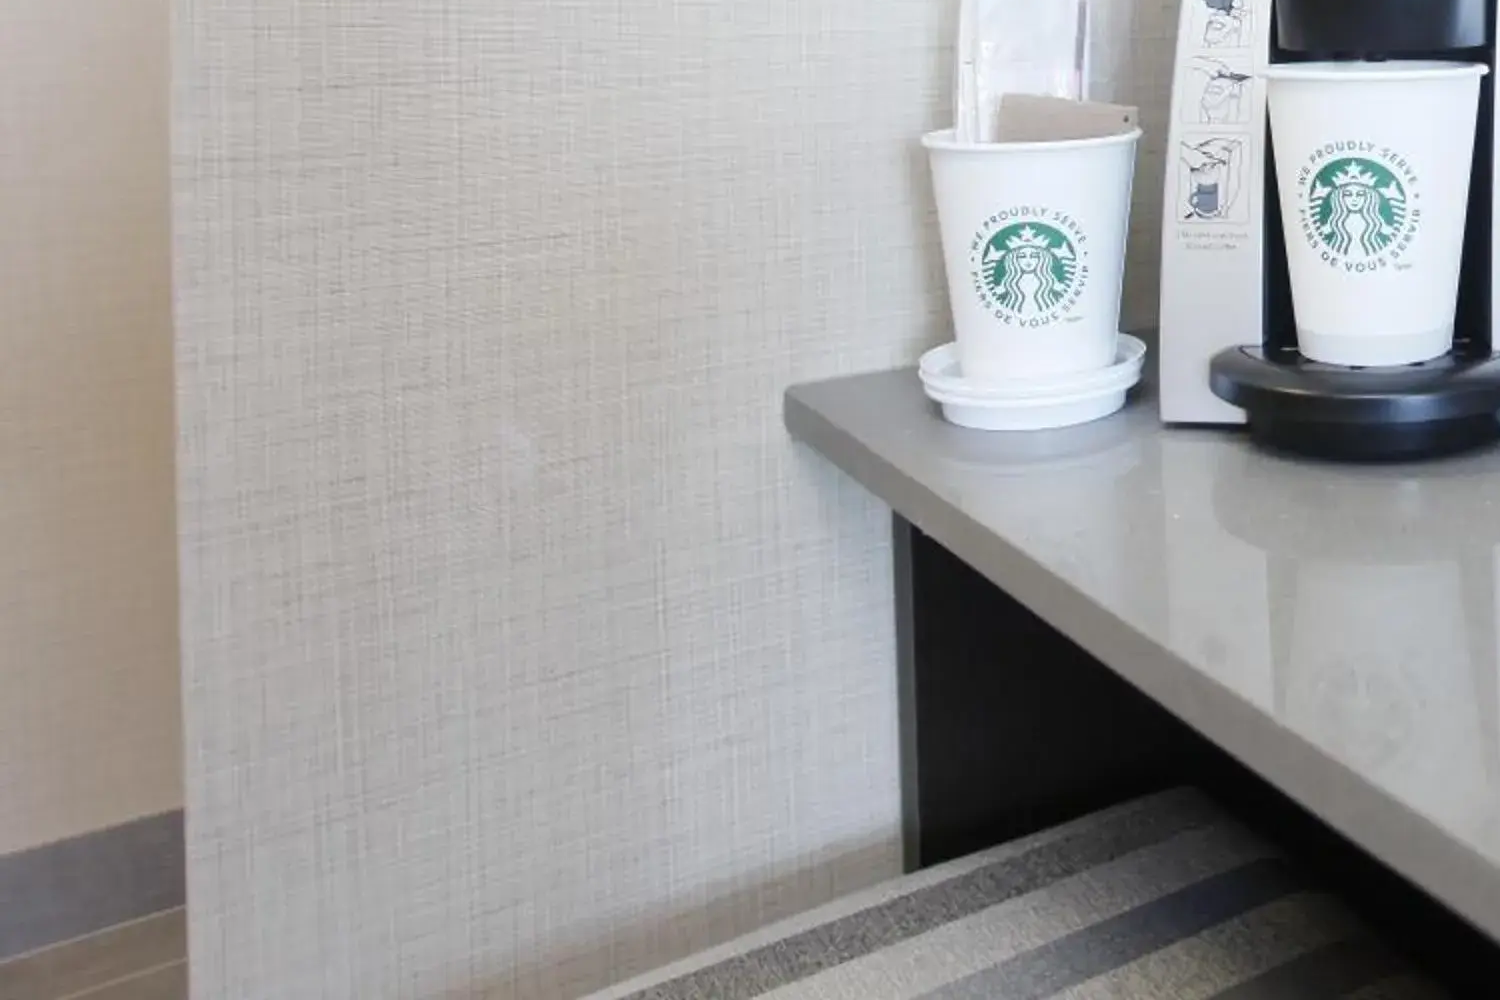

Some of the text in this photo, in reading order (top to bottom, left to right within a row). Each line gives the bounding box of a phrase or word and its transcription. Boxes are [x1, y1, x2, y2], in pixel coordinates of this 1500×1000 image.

[1309, 140, 1376, 164] PROUDLY
[1379, 148, 1418, 186] SERVE
[1344, 257, 1387, 273] VOUS
